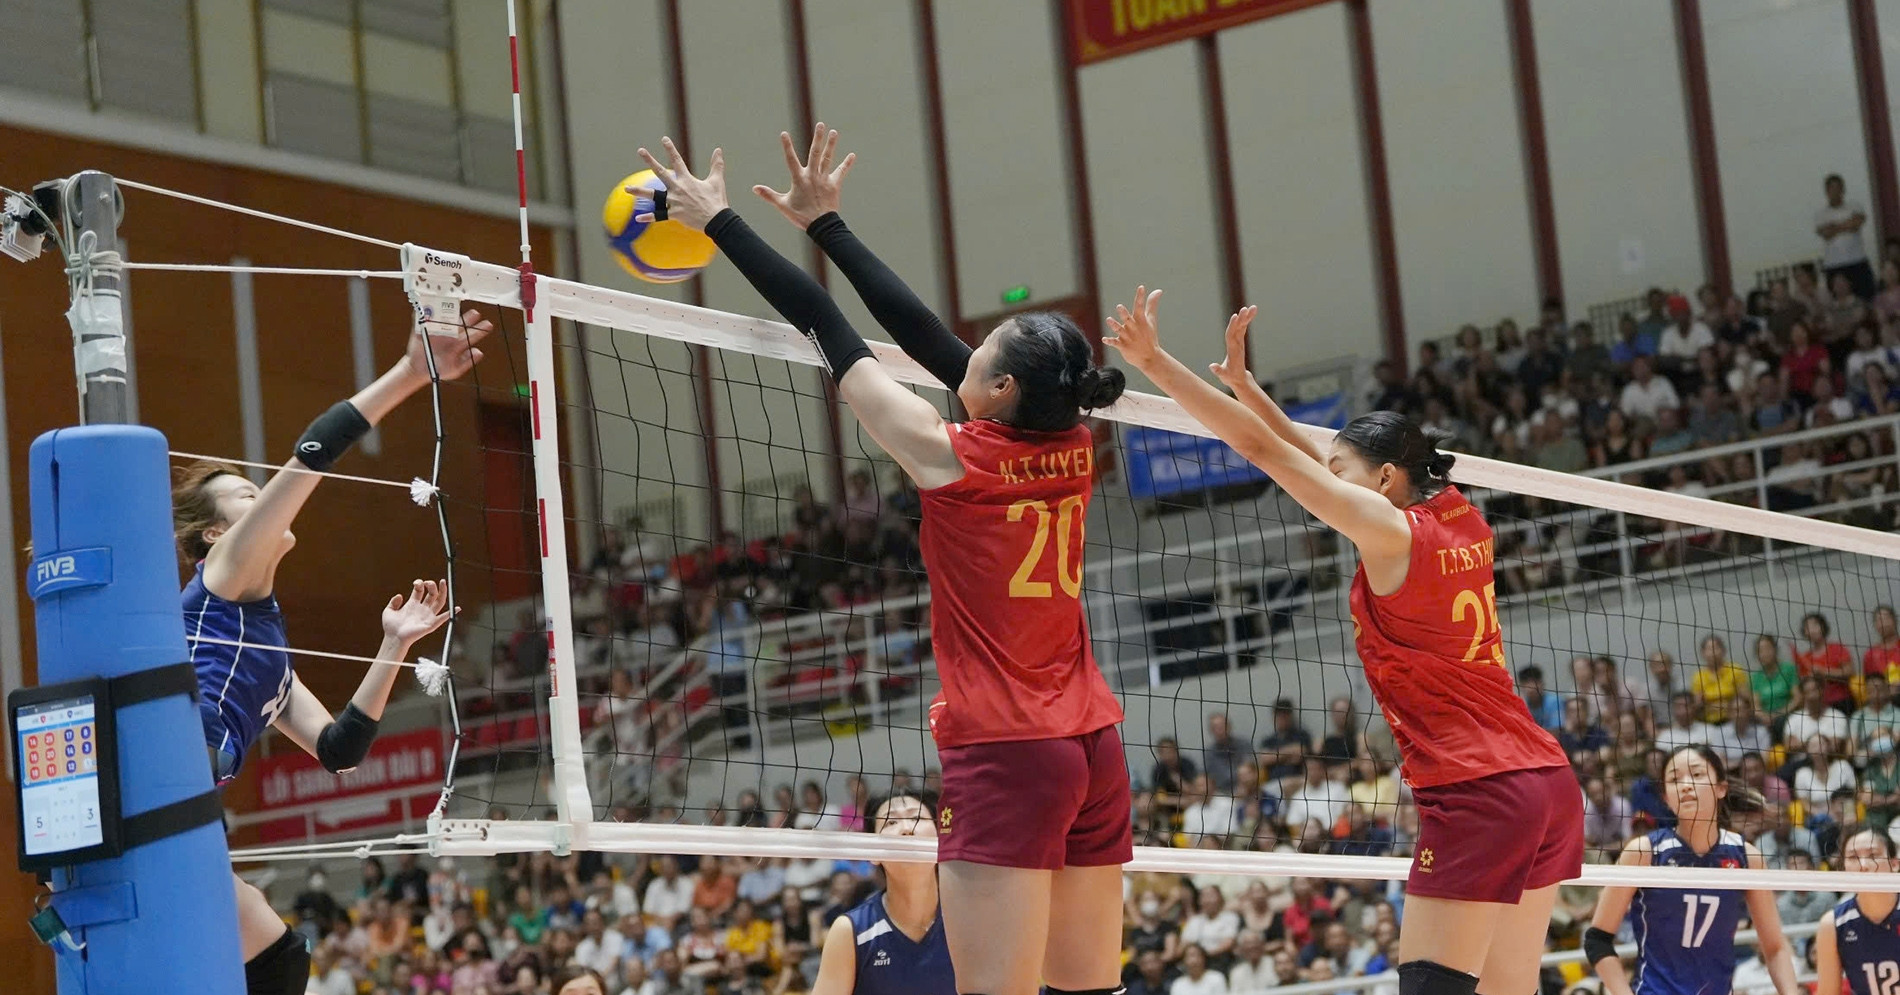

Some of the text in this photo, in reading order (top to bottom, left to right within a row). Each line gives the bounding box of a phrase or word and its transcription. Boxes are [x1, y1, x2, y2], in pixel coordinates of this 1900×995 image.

[434, 256, 462, 269] Senoh
[1006, 495, 1085, 598] 20
[37, 556, 75, 582] FIVB
[1452, 580, 1506, 670] 25
[36, 816, 43, 829] 5
[87, 808, 94, 820] 3
[1681, 894, 1720, 948] 17
[1862, 960, 1900, 995] 12
